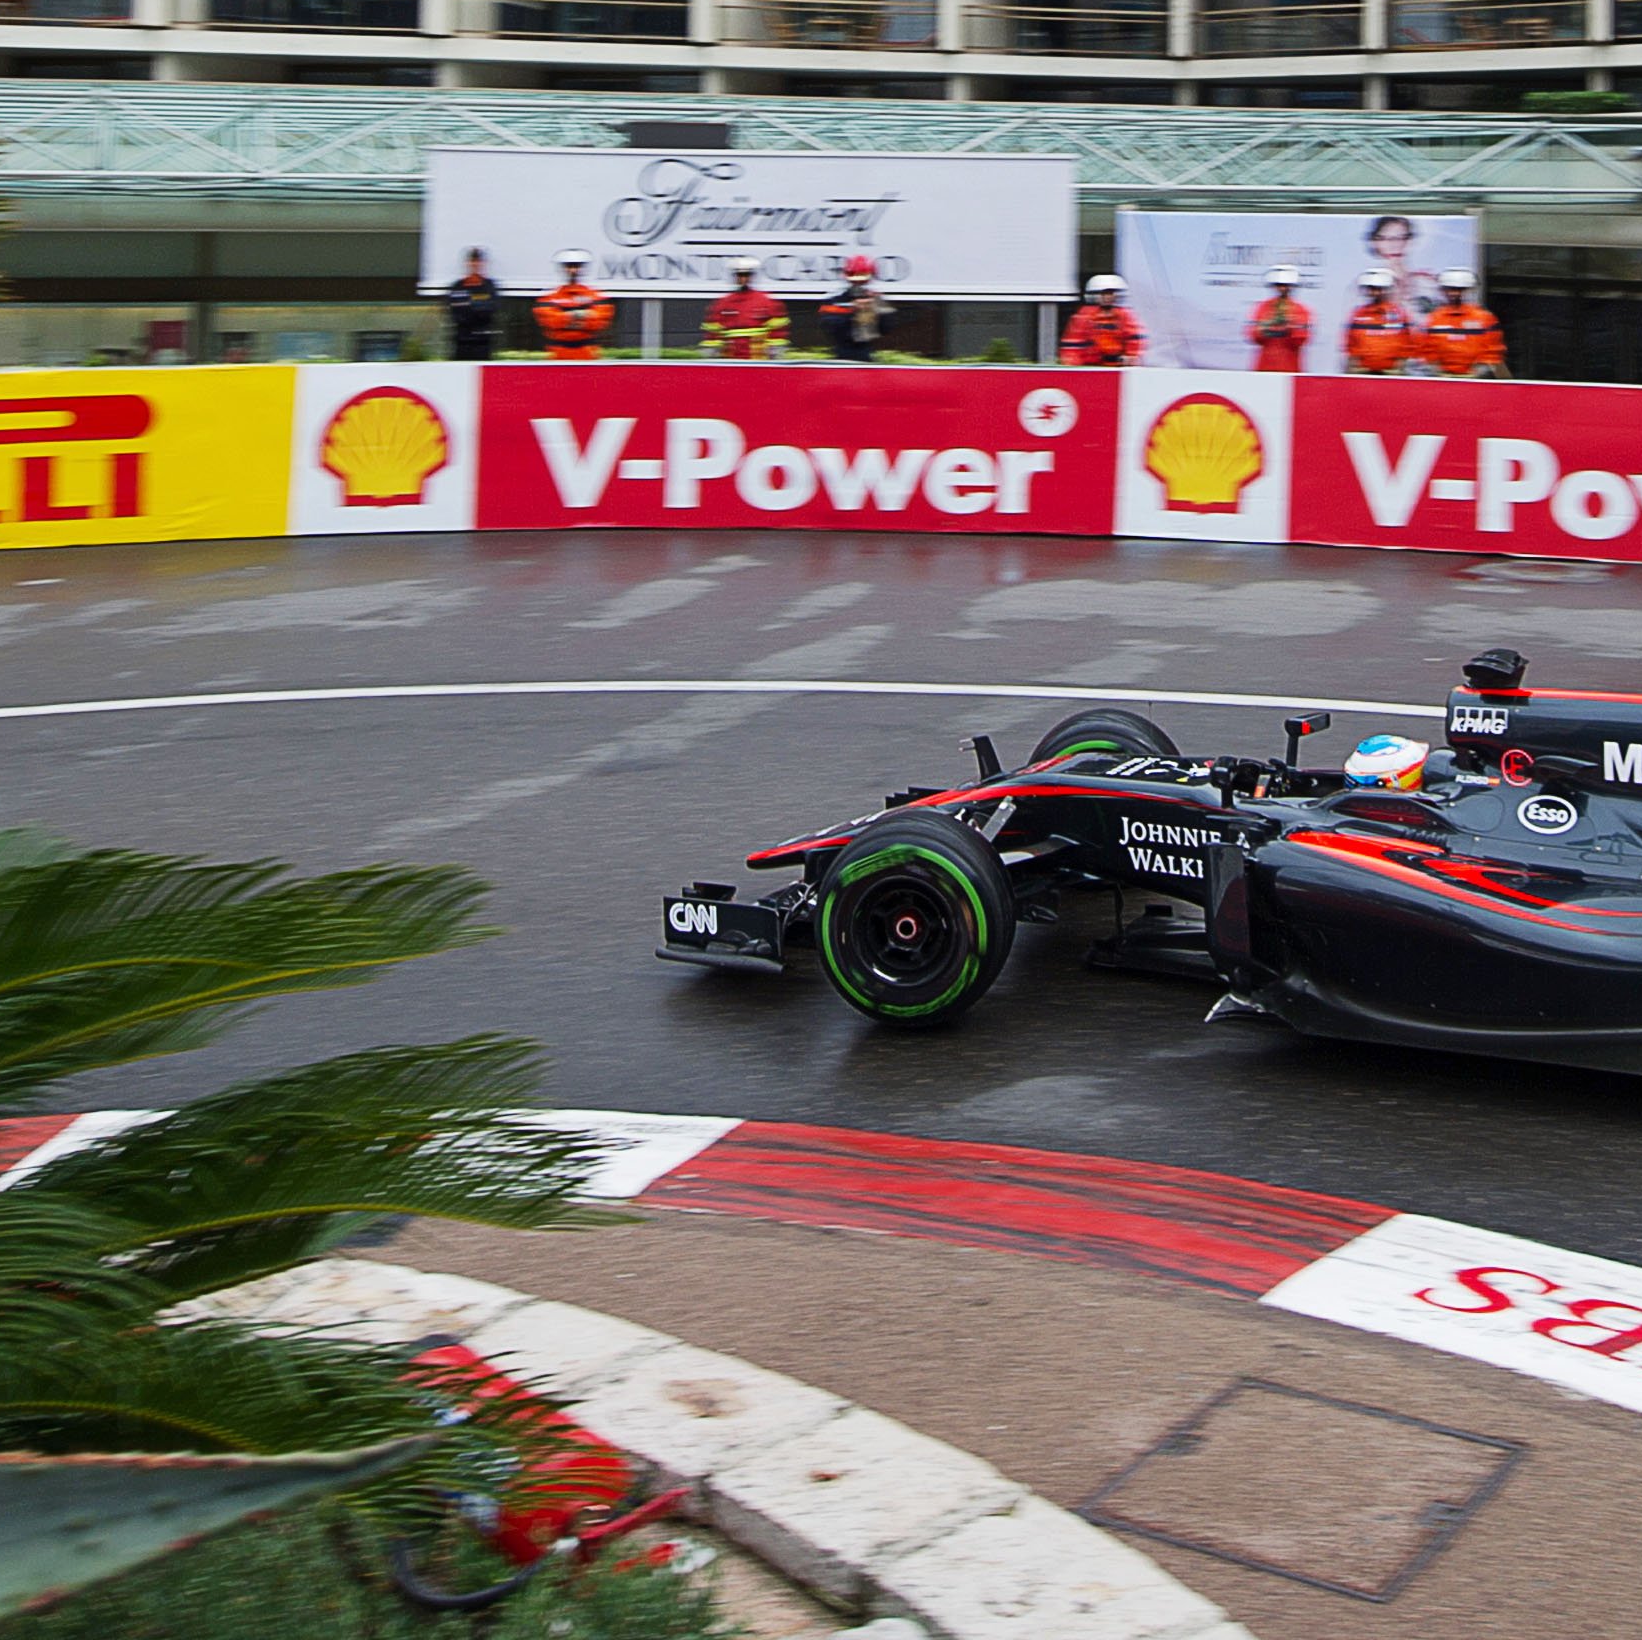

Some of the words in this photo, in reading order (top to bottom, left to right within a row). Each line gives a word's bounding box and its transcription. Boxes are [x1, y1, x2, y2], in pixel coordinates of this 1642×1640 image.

[603, 158, 907, 247] Fairmont
[762, 254, 911, 283] CARO
[530, 417, 1054, 514] V-Power
[1450, 715, 1508, 735] KPMG
[1119, 817, 1222, 847] JOHNNIE
[669, 902, 718, 935] CNN
